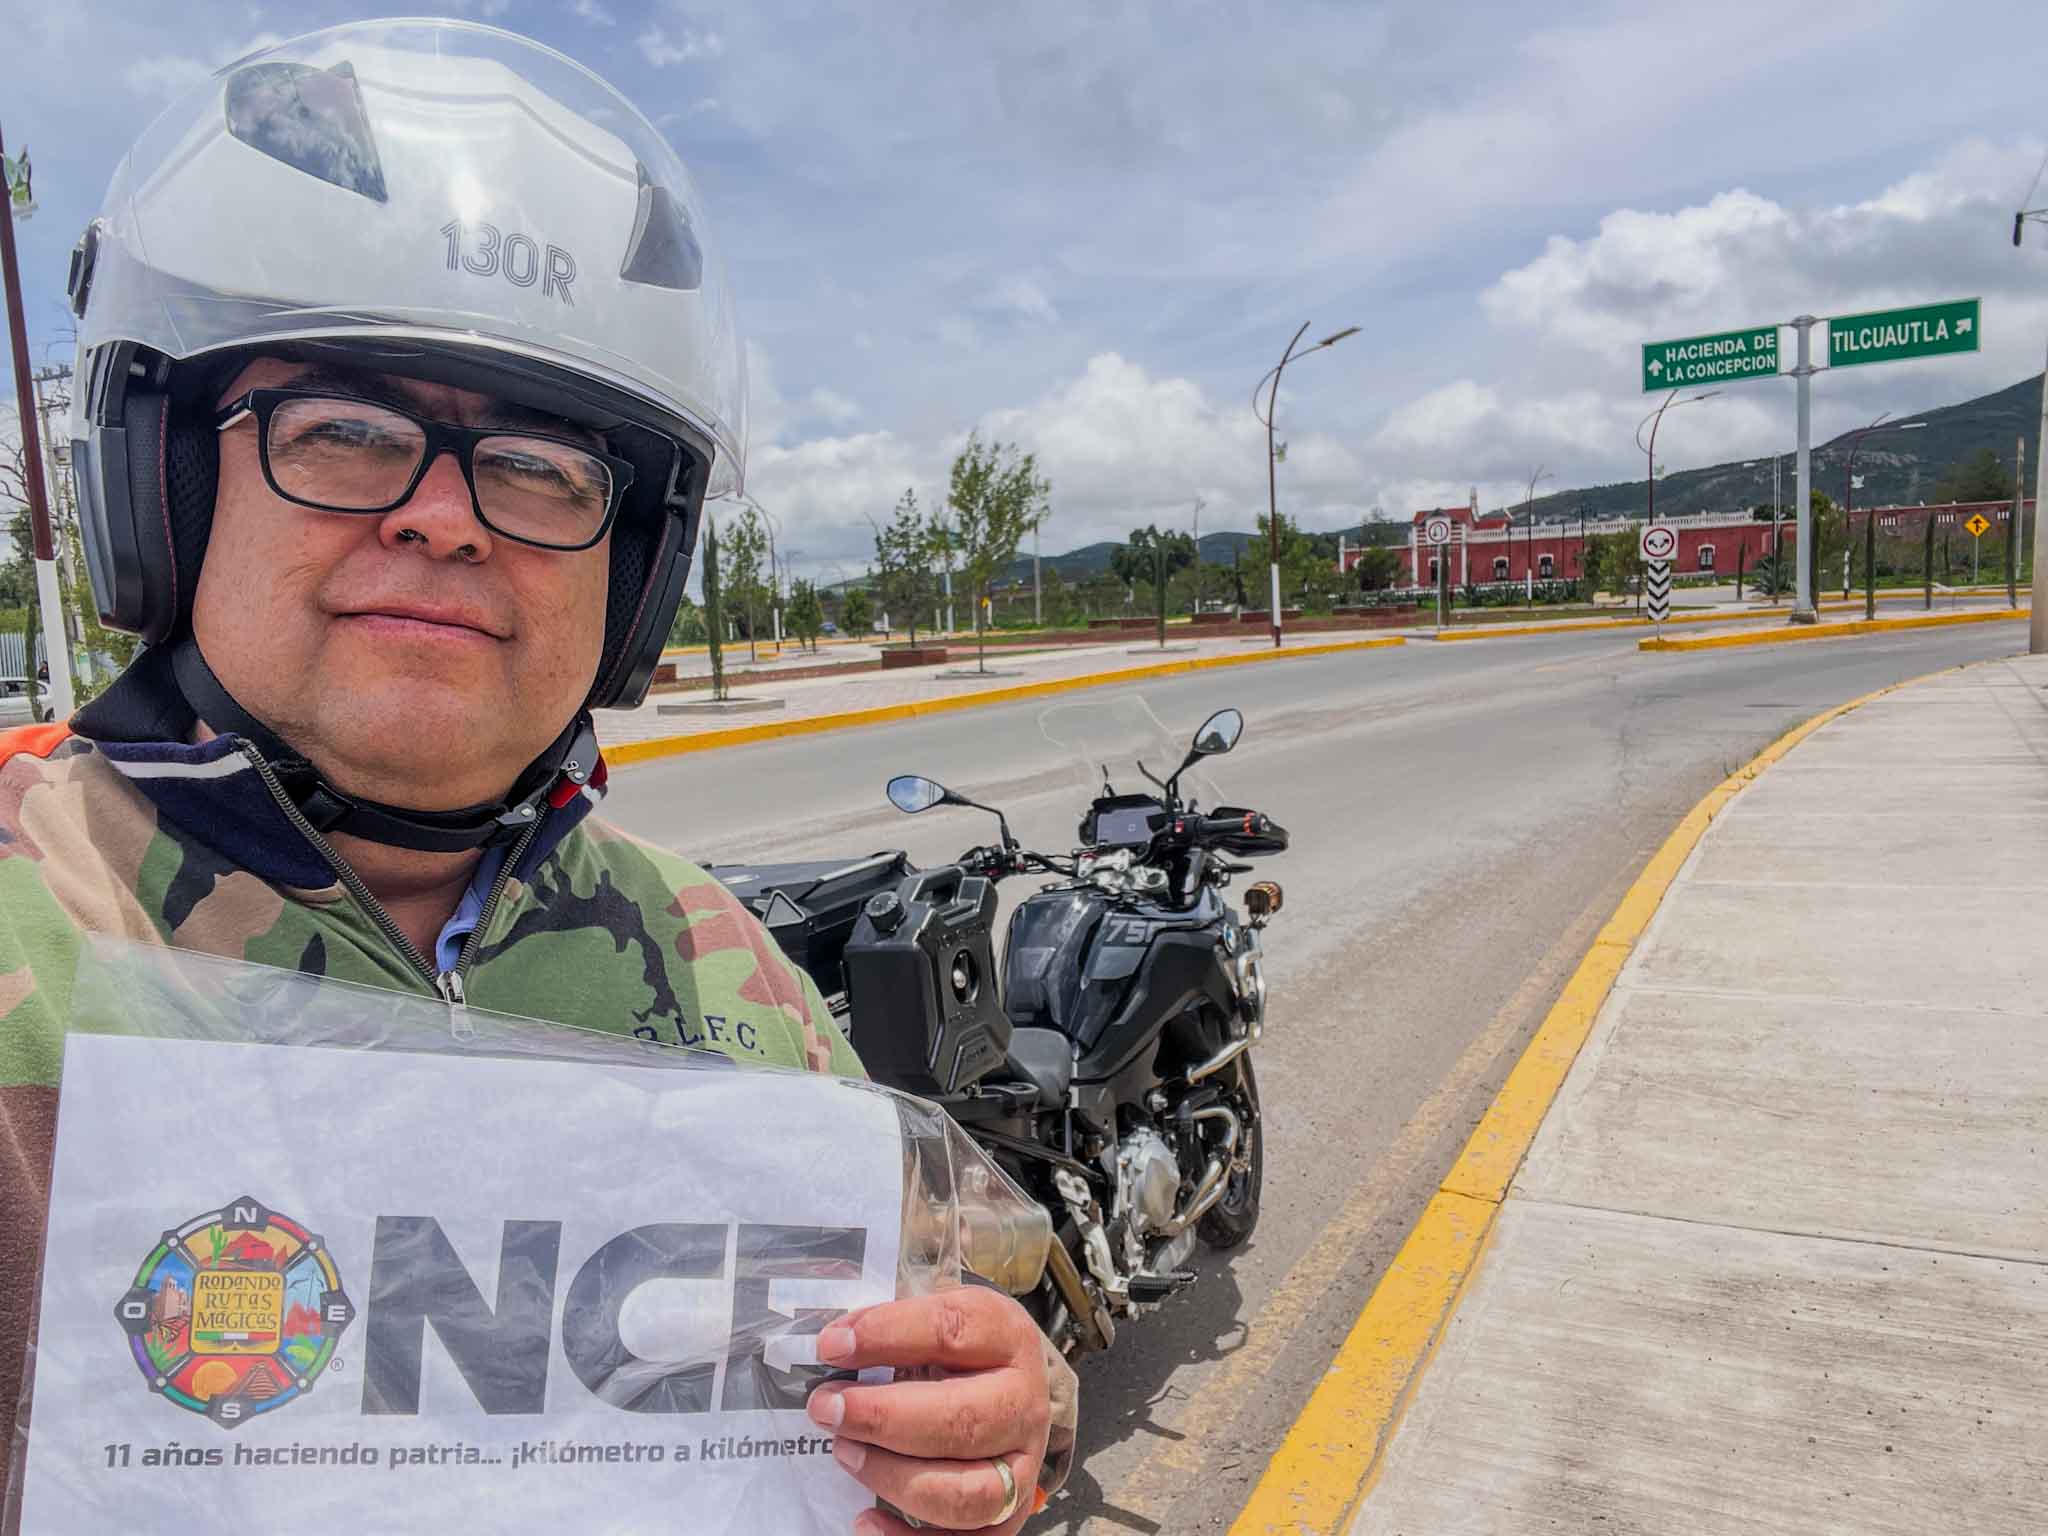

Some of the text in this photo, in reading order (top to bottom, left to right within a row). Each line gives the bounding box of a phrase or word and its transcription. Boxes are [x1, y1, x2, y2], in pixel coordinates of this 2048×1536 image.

[440, 218, 577, 308] 130R
[1665, 333, 1777, 363] HACIENDA DE
[1832, 319, 1950, 353] TILCUAUTLA
[1666, 354, 1777, 382] LA CONCEPCION
[234, 1207, 257, 1224] N
[327, 1304, 346, 1321] E
[220, 1402, 241, 1418] S
[104, 1443, 132, 1467] 11
[141, 1441, 224, 1467] años
[234, 1442, 379, 1467] haciendo
[389, 1443, 502, 1470] patria...
[511, 1439, 665, 1469] ¡kilómetro
[674, 1444, 691, 1463] a
